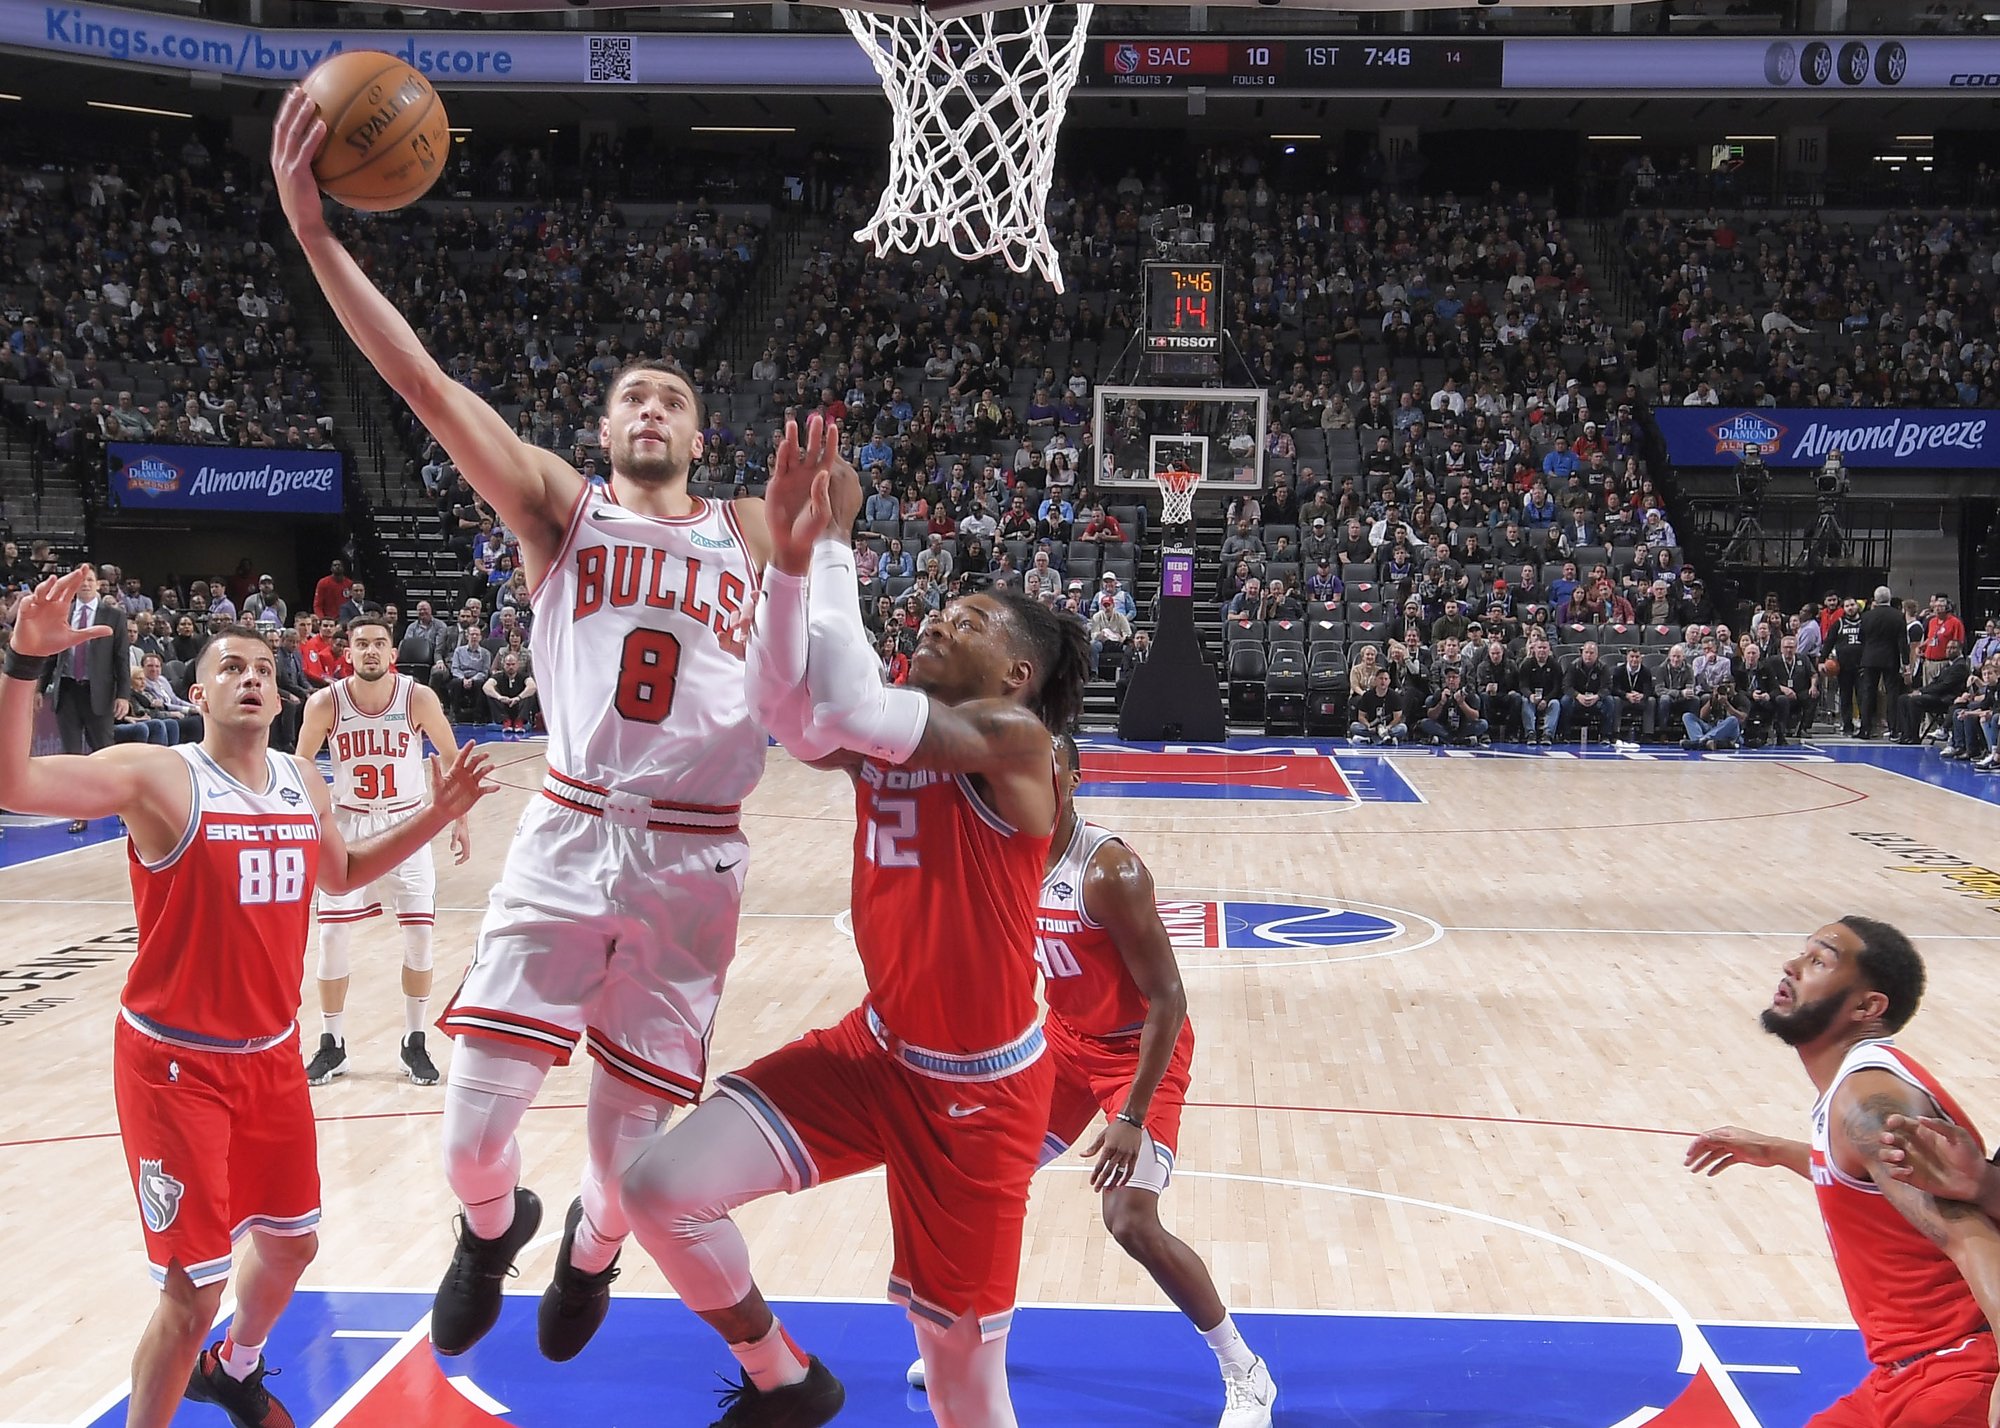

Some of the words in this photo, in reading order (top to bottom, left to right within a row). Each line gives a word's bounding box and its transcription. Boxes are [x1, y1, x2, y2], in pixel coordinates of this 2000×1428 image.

[1148, 47, 1191, 66] SAC
[1247, 48, 1270, 66] 10
[1305, 47, 1340, 66] 1ST
[1364, 47, 1411, 66] 7:46
[1446, 52, 1461, 63] 14
[1114, 75, 1161, 85] TIMEOUTS
[1166, 75, 1173, 85] 7
[1232, 75, 1264, 85] FOULS
[1268, 75, 1275, 85] 0
[346, 74, 427, 157] SPALDING
[1171, 271, 1213, 293] 7:46
[1174, 296, 1207, 328] 14
[1168, 337, 1217, 348] TISSOT
[1734, 417, 1764, 430] BLUE
[1718, 426, 1778, 441] DIAMOND
[1792, 417, 1900, 459] Almond
[1895, 419, 1987, 457] Breeze
[1722, 441, 1776, 453] ALMDS
[128, 467, 177, 480] DIAMOND
[141, 459, 164, 471] BLUE
[189, 464, 271, 496] Almond
[267, 467, 333, 496] Breeze
[573, 544, 746, 644] BULLS
[613, 627, 682, 725] 8
[337, 729, 410, 762] BULLS
[353, 764, 398, 800] 31
[205, 823, 317, 841] SACTOWN
[239, 847, 306, 905] 88
